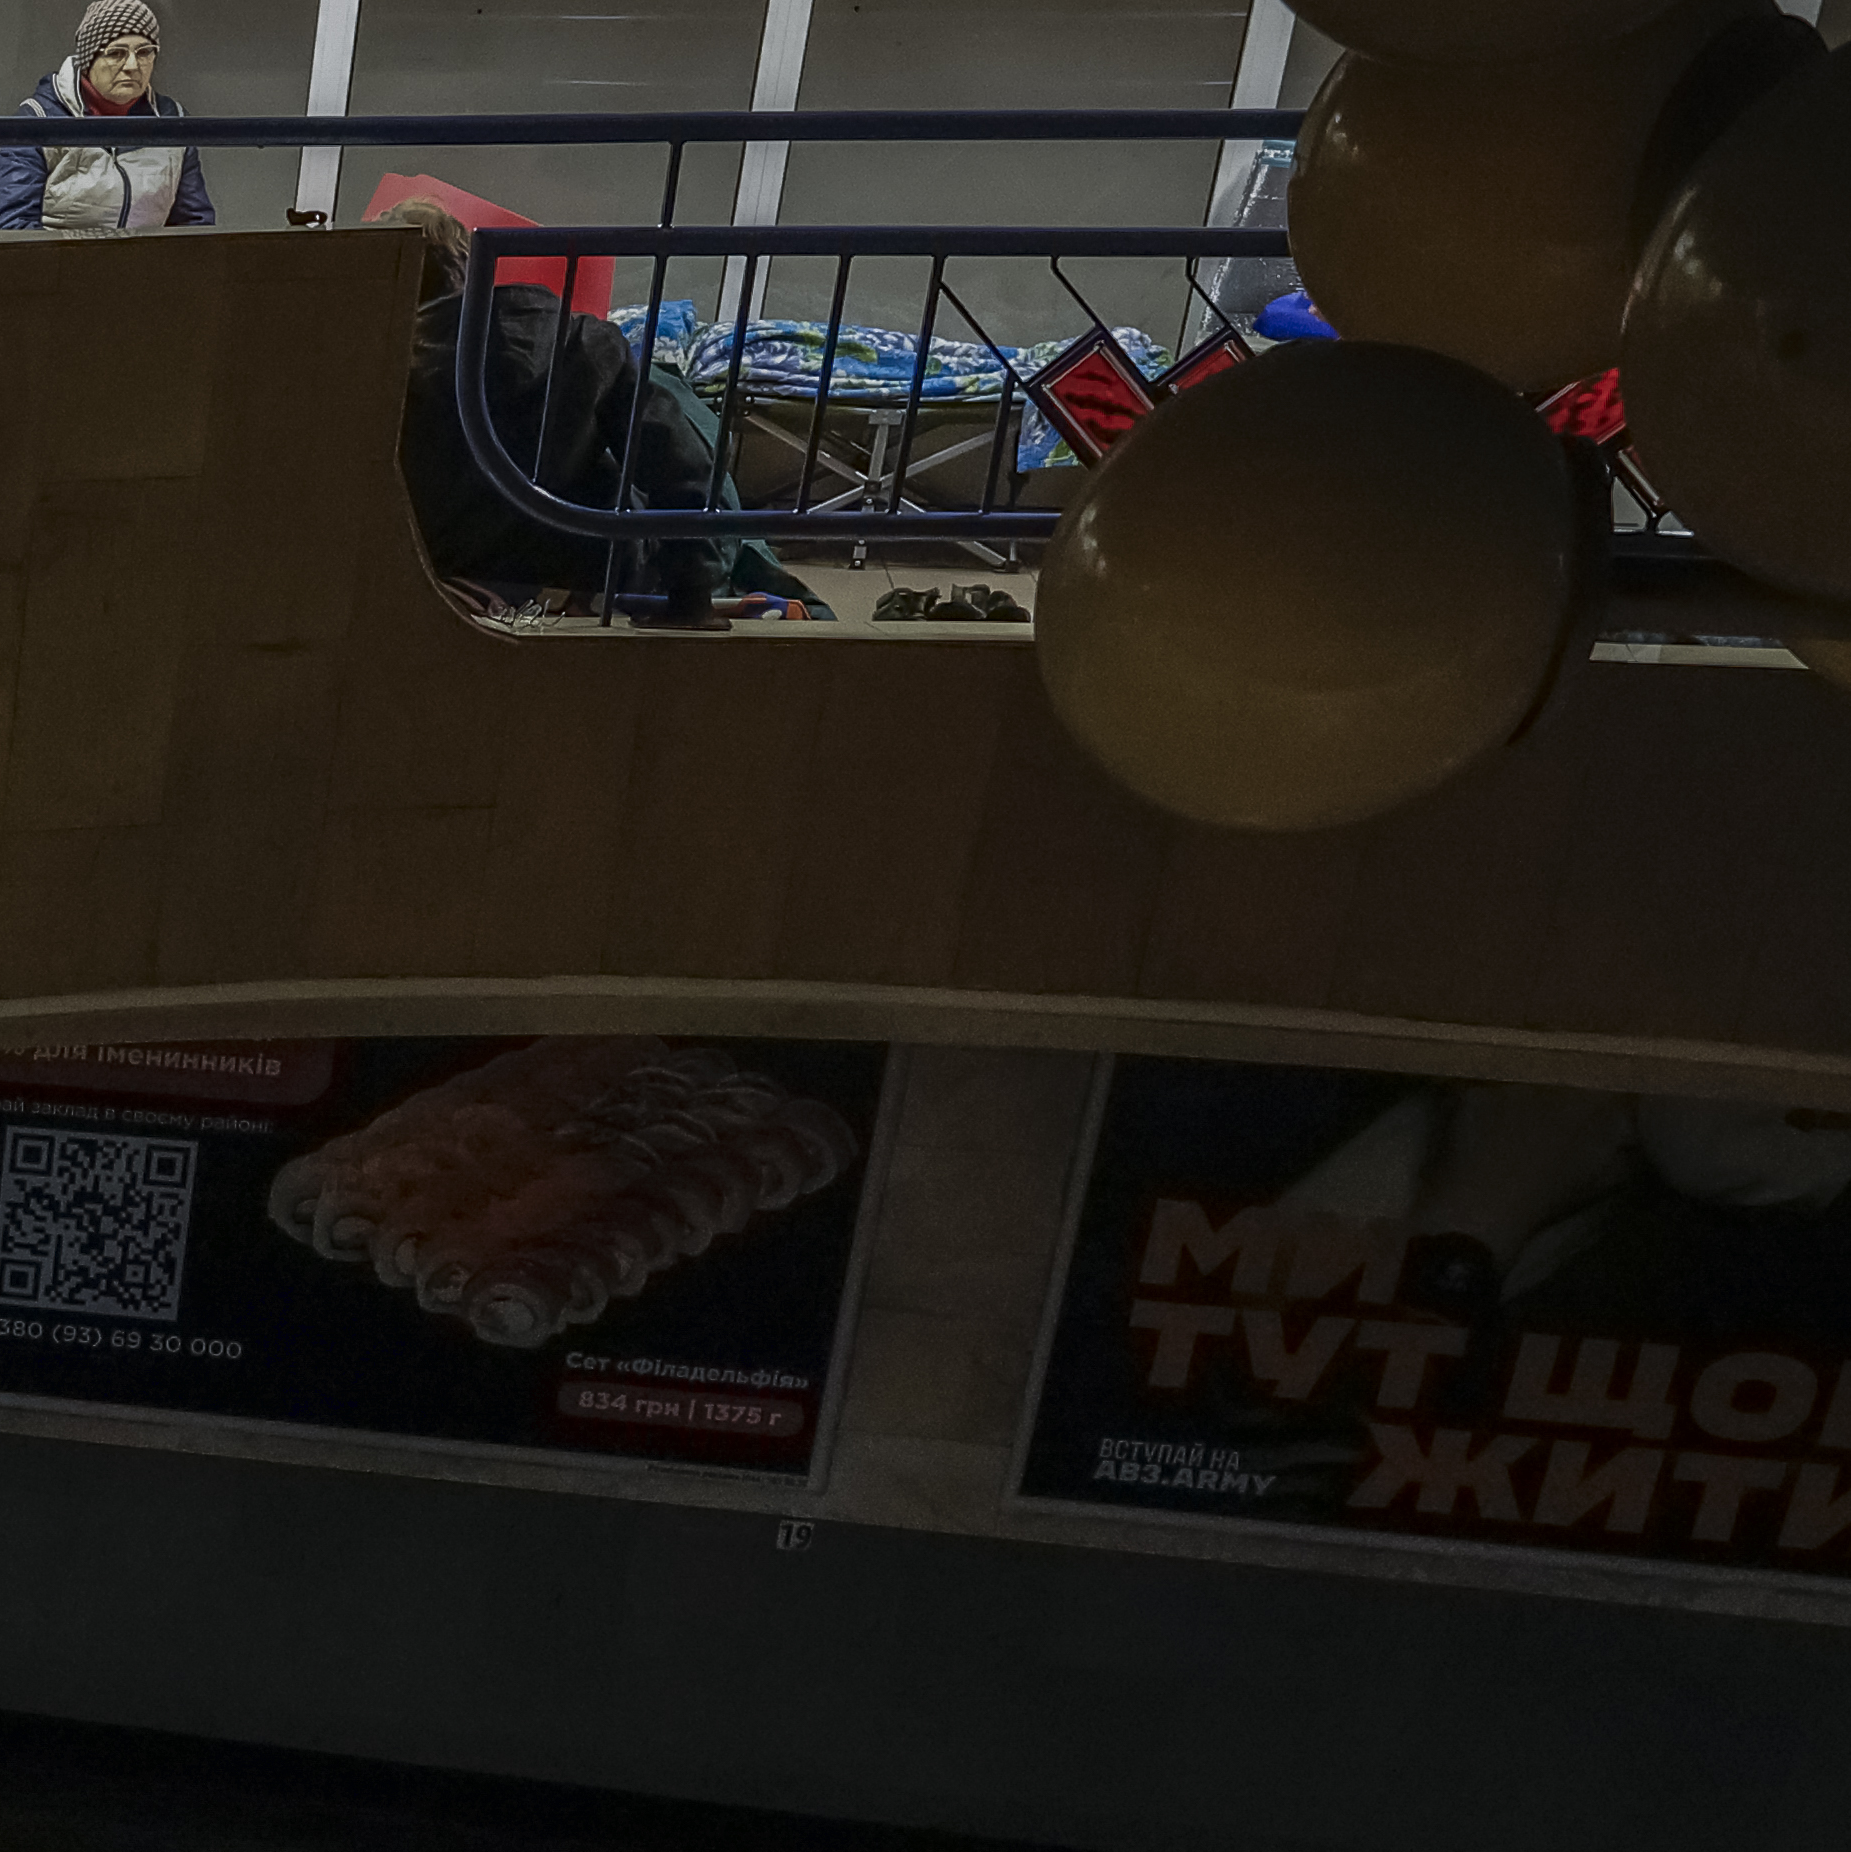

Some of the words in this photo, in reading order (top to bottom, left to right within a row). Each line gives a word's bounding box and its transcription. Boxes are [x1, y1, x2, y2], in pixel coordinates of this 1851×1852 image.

[33, 1045, 88, 1062] для
[97, 1047, 282, 1078] іменинників
[32, 1102, 99, 1121] заклад
[105, 1108, 116, 1120] в
[122, 1109, 195, 1130] своєму
[1138, 1199, 1401, 1306] МИ
[52, 1325, 102, 1348] (93)
[111, 1332, 142, 1349] 69
[149, 1333, 182, 1353] 30
[190, 1338, 243, 1359] 000
[565, 1351, 612, 1372] Сет
[616, 1357, 809, 1390] «Філадельфія»
[1127, 1300, 1470, 1410] ТУТ
[1503, 1331, 1851, 1447] ЩО
[578, 1391, 628, 1411] 834
[635, 1399, 680, 1421] грн
[704, 1402, 763, 1425] 1375
[769, 1411, 783, 1427] г
[1099, 1437, 1206, 1467] ВСТУПАЙ
[1209, 1449, 1241, 1472] НА
[782, 1524, 813, 1548] 19
